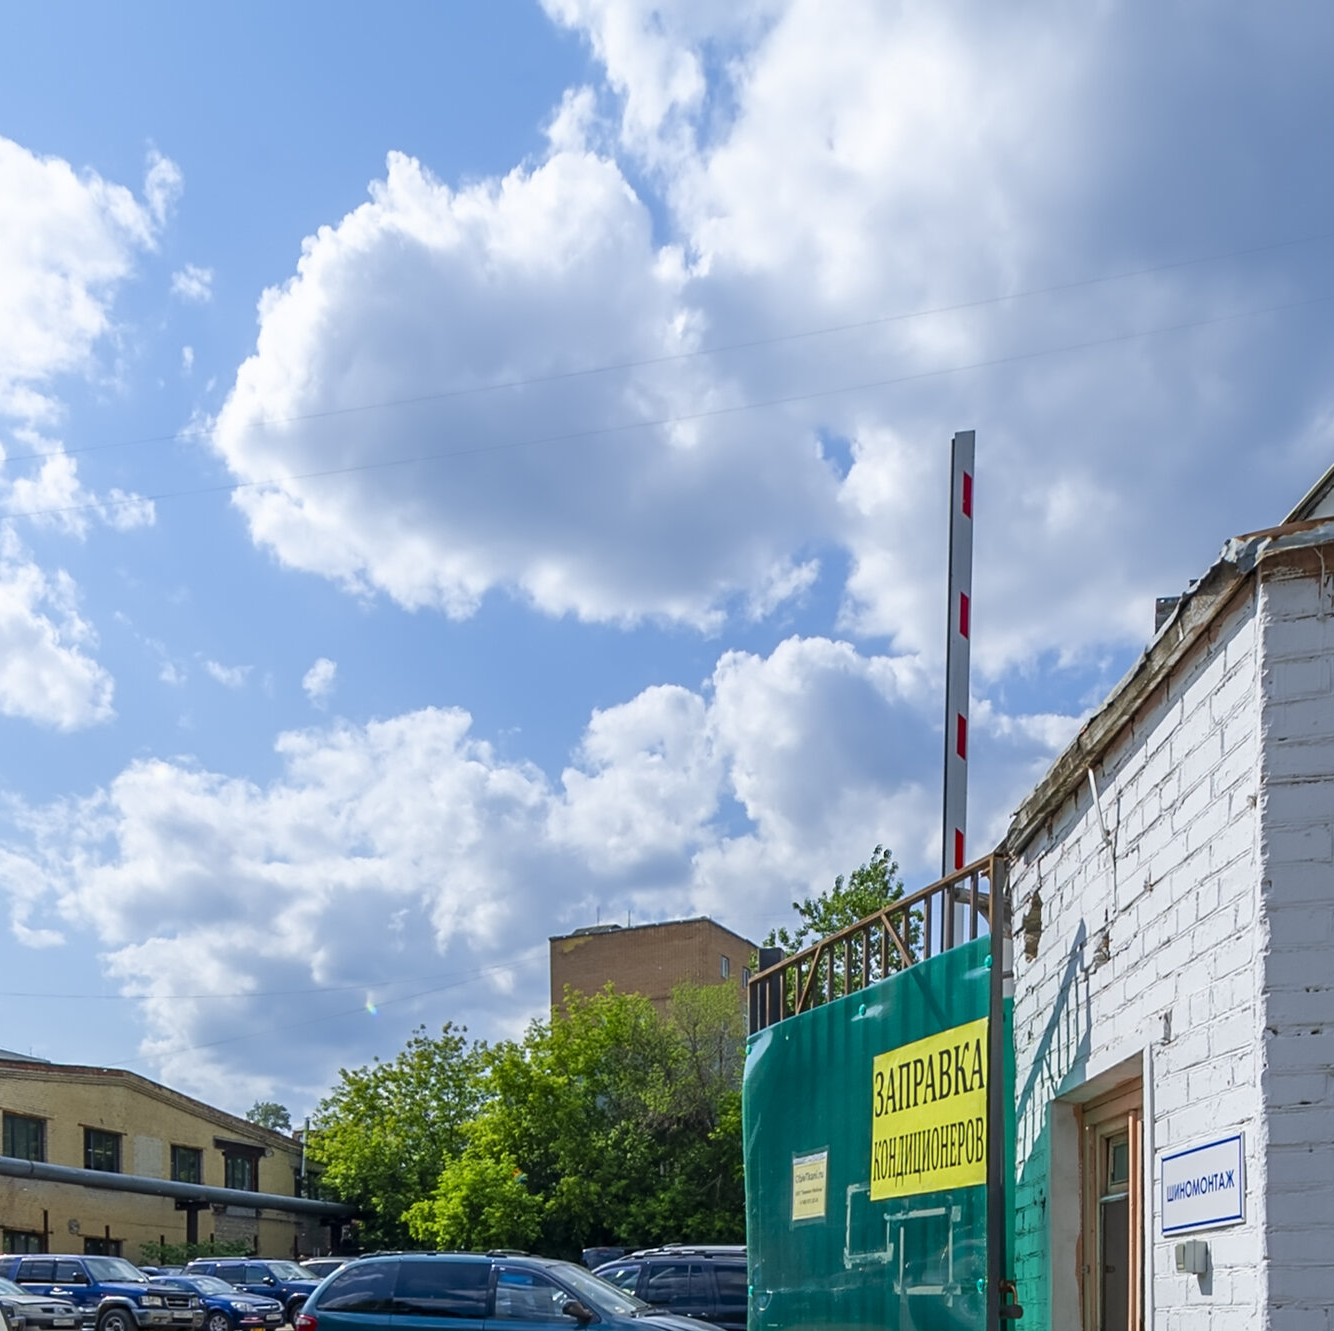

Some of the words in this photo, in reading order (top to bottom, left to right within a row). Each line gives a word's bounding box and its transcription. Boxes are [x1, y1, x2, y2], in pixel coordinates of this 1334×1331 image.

[874, 1038, 985, 1118] ЗАПРАВКА
[873, 1117, 984, 1188] КОНДИЦИОНЕРОВ
[1166, 1169, 1235, 1202] ШИНОМОНТАЖ
